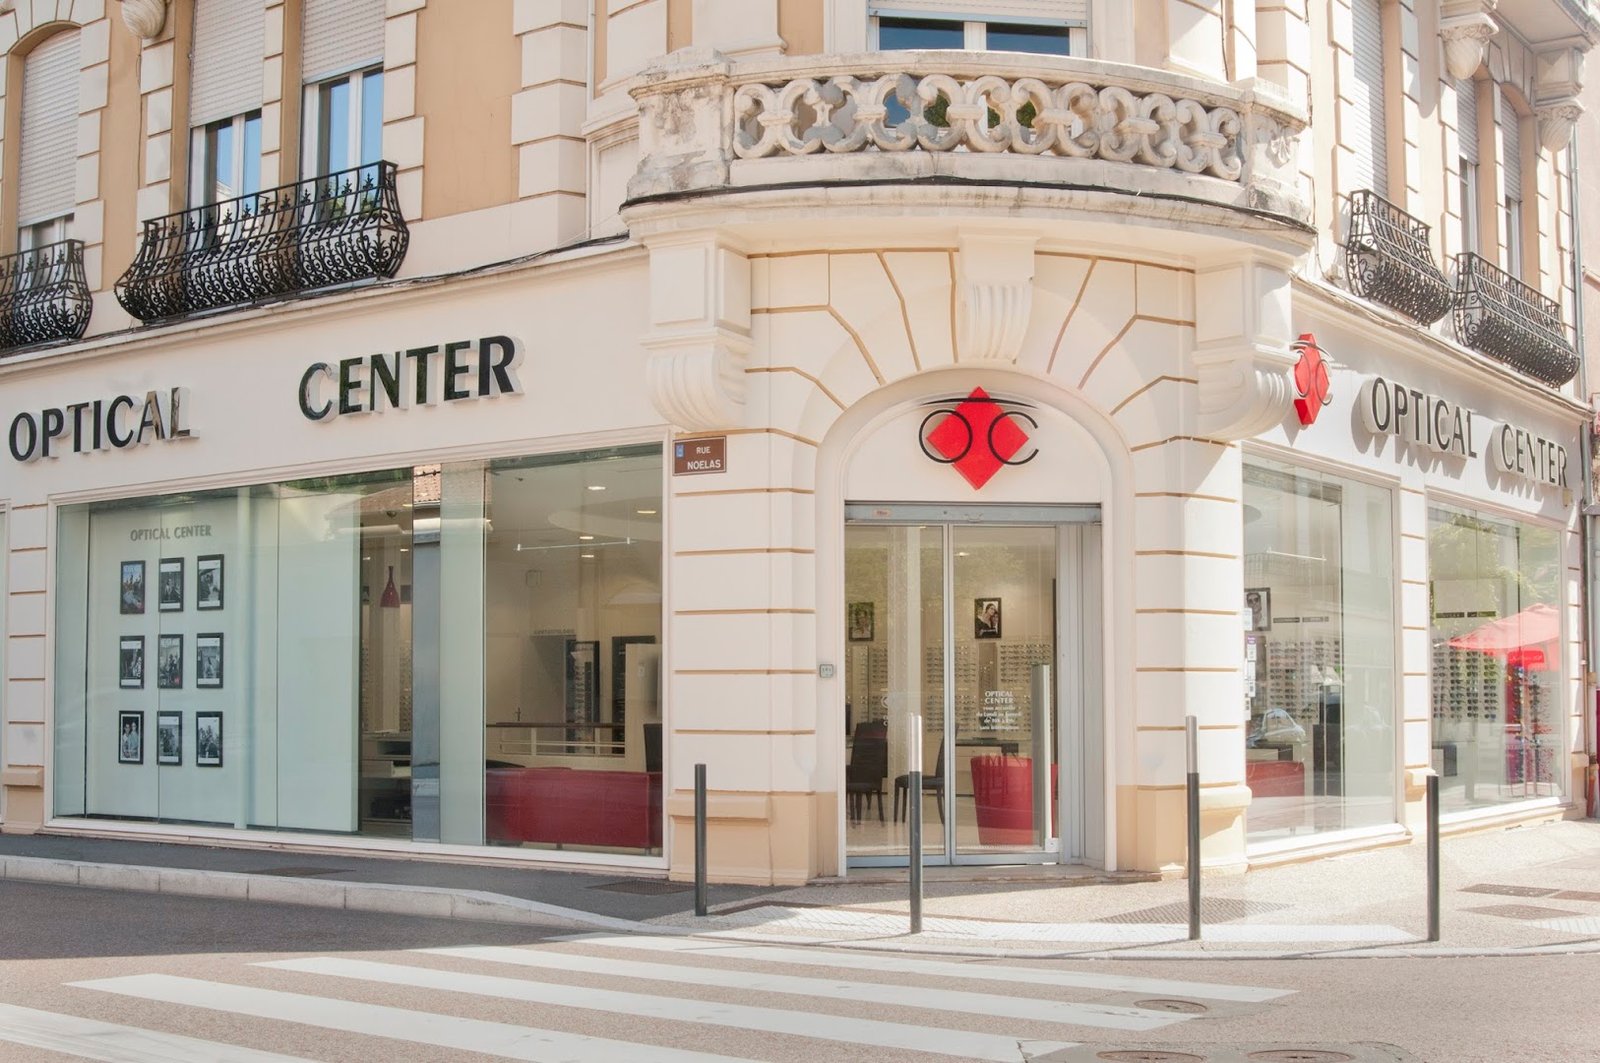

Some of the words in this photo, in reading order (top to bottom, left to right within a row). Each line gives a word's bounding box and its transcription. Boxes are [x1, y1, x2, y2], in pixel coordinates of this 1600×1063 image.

[9, 387, 193, 462] OPTICAL
[299, 335, 518, 421] CENTER
[1371, 376, 1477, 459] OPTICAL
[1500, 422, 1568, 488] CENTER
[696, 446, 711, 455] RUE
[687, 459, 722, 470] NOELAS
[130, 528, 170, 541] OPTICAL
[174, 525, 212, 539] CENTER
